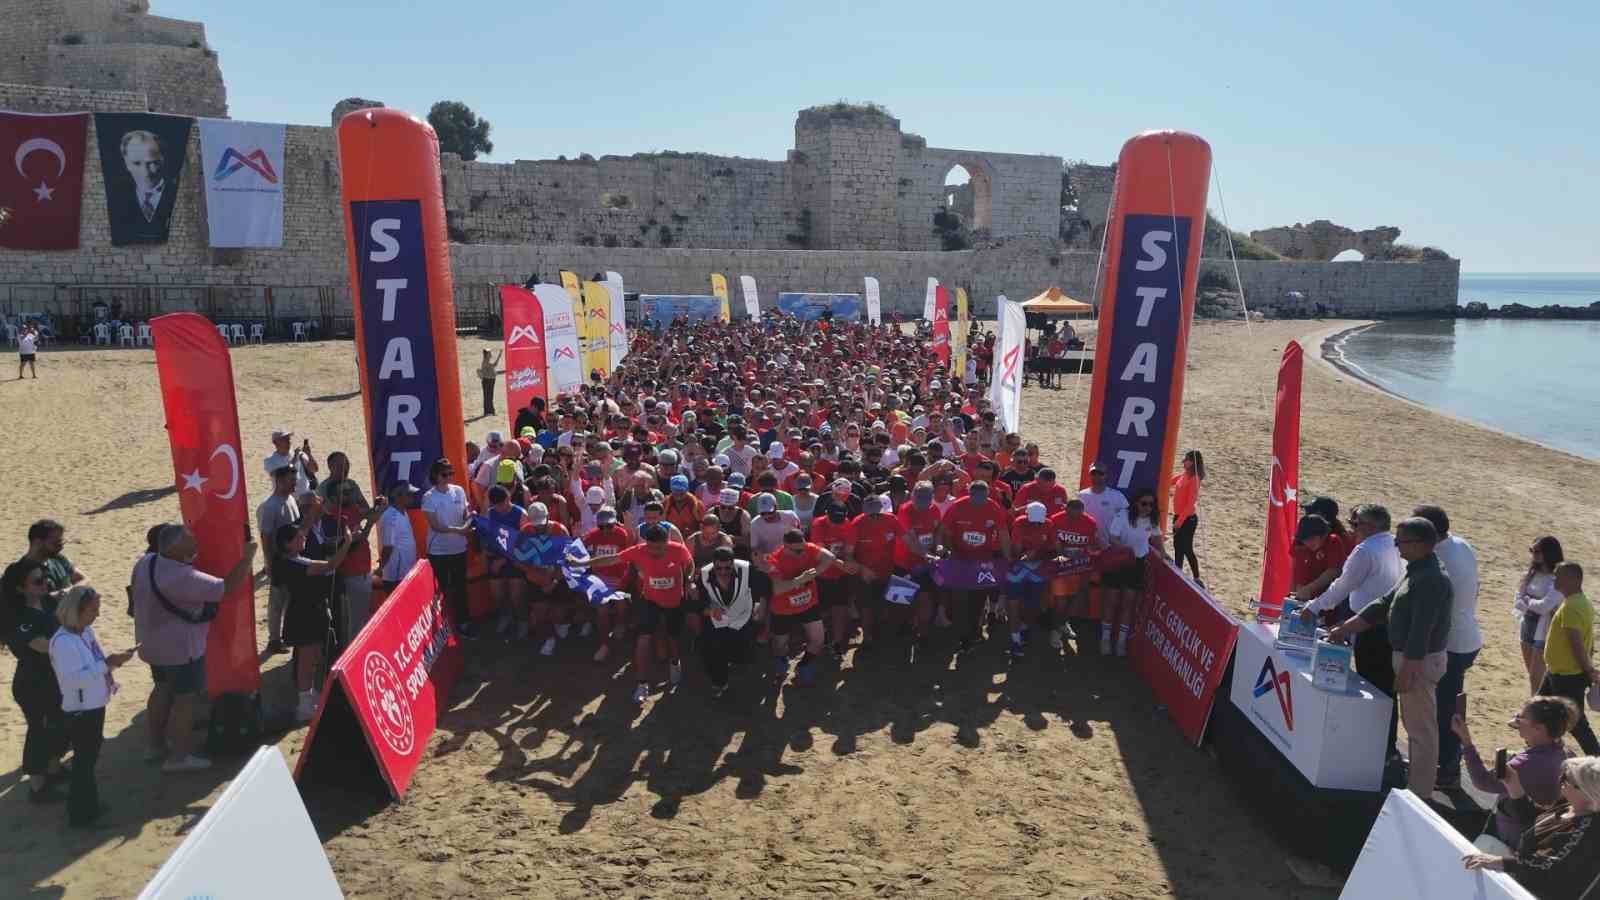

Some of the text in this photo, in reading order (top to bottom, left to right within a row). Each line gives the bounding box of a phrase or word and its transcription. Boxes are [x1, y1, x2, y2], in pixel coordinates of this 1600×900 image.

[369, 218, 421, 481] START
[1116, 230, 1172, 489] START
[1166, 611, 1200, 660] GENÇLİK
[1199, 646, 1215, 671] VE
[406, 660, 429, 701] SPOR
[1162, 645, 1206, 699] BAKANLIĞI
